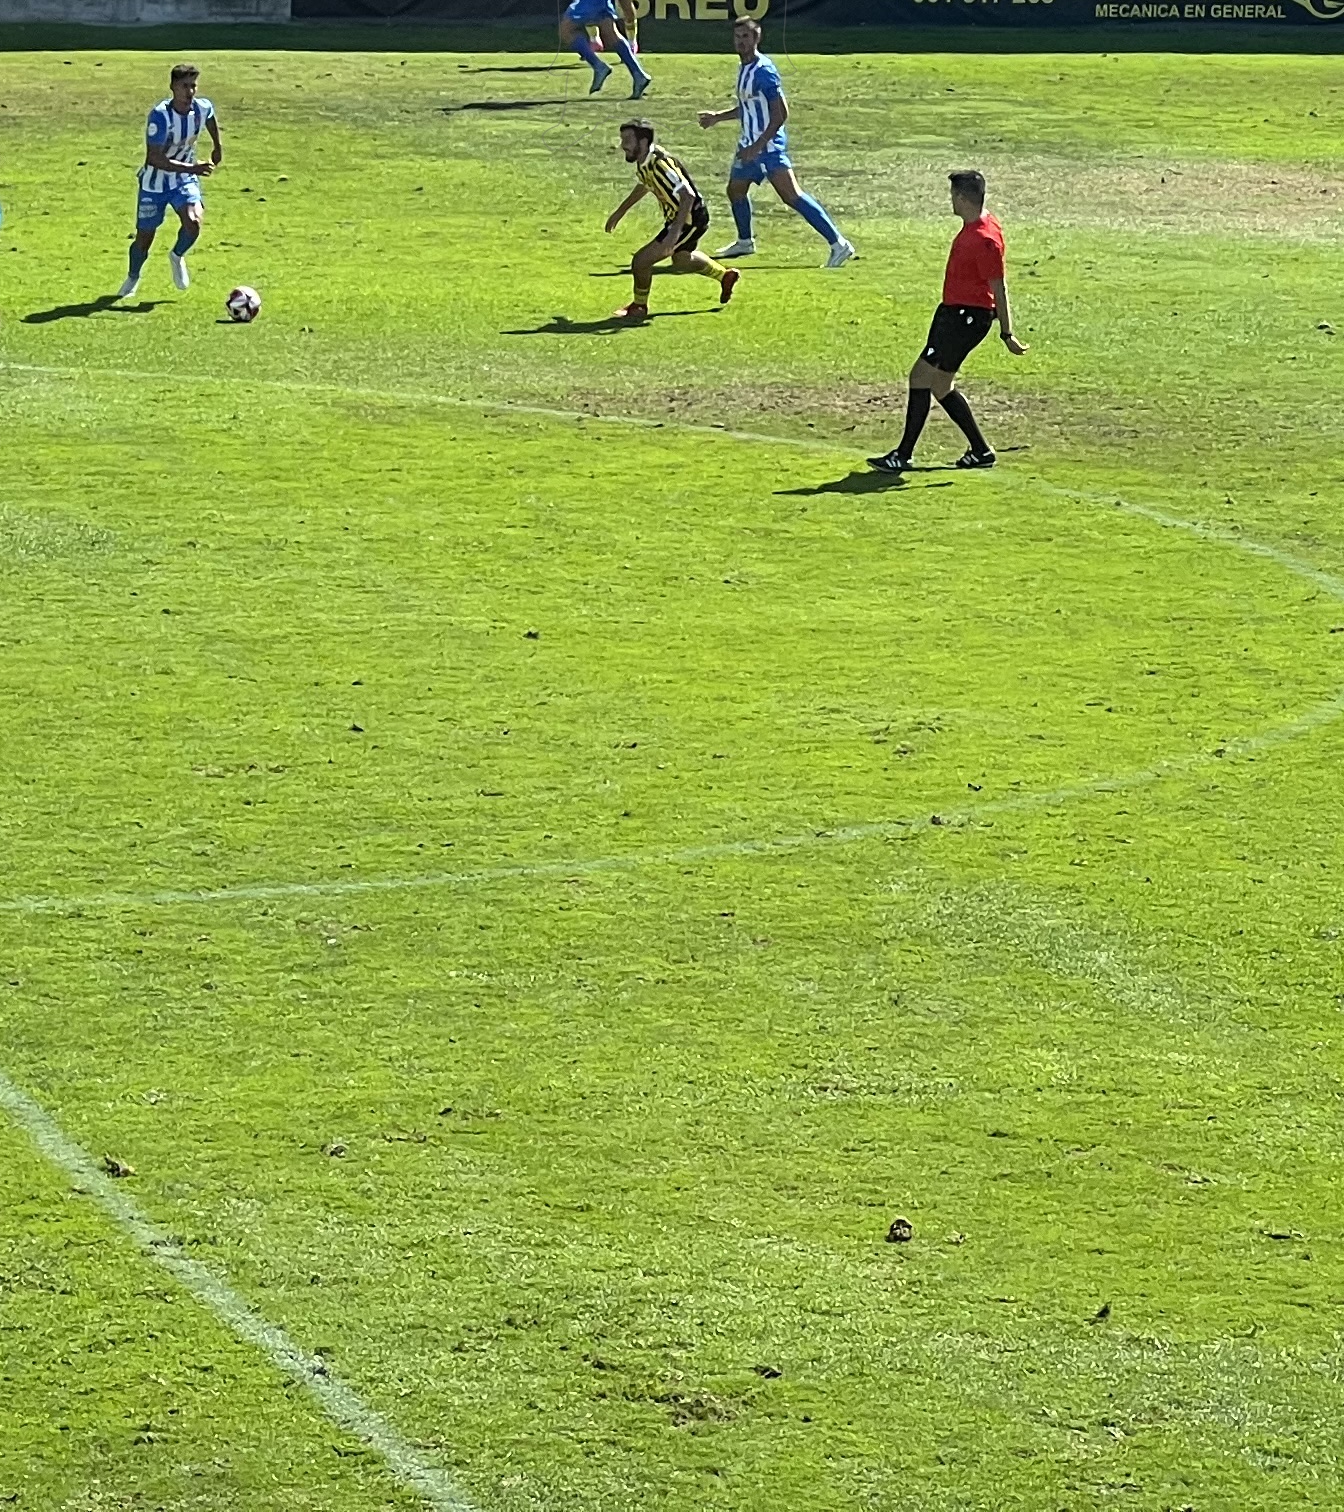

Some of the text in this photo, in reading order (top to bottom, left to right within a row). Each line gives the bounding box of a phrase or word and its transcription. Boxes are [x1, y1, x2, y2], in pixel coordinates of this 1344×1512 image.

[1094, 3, 1287, 19] MECANICA EN GENERAL
